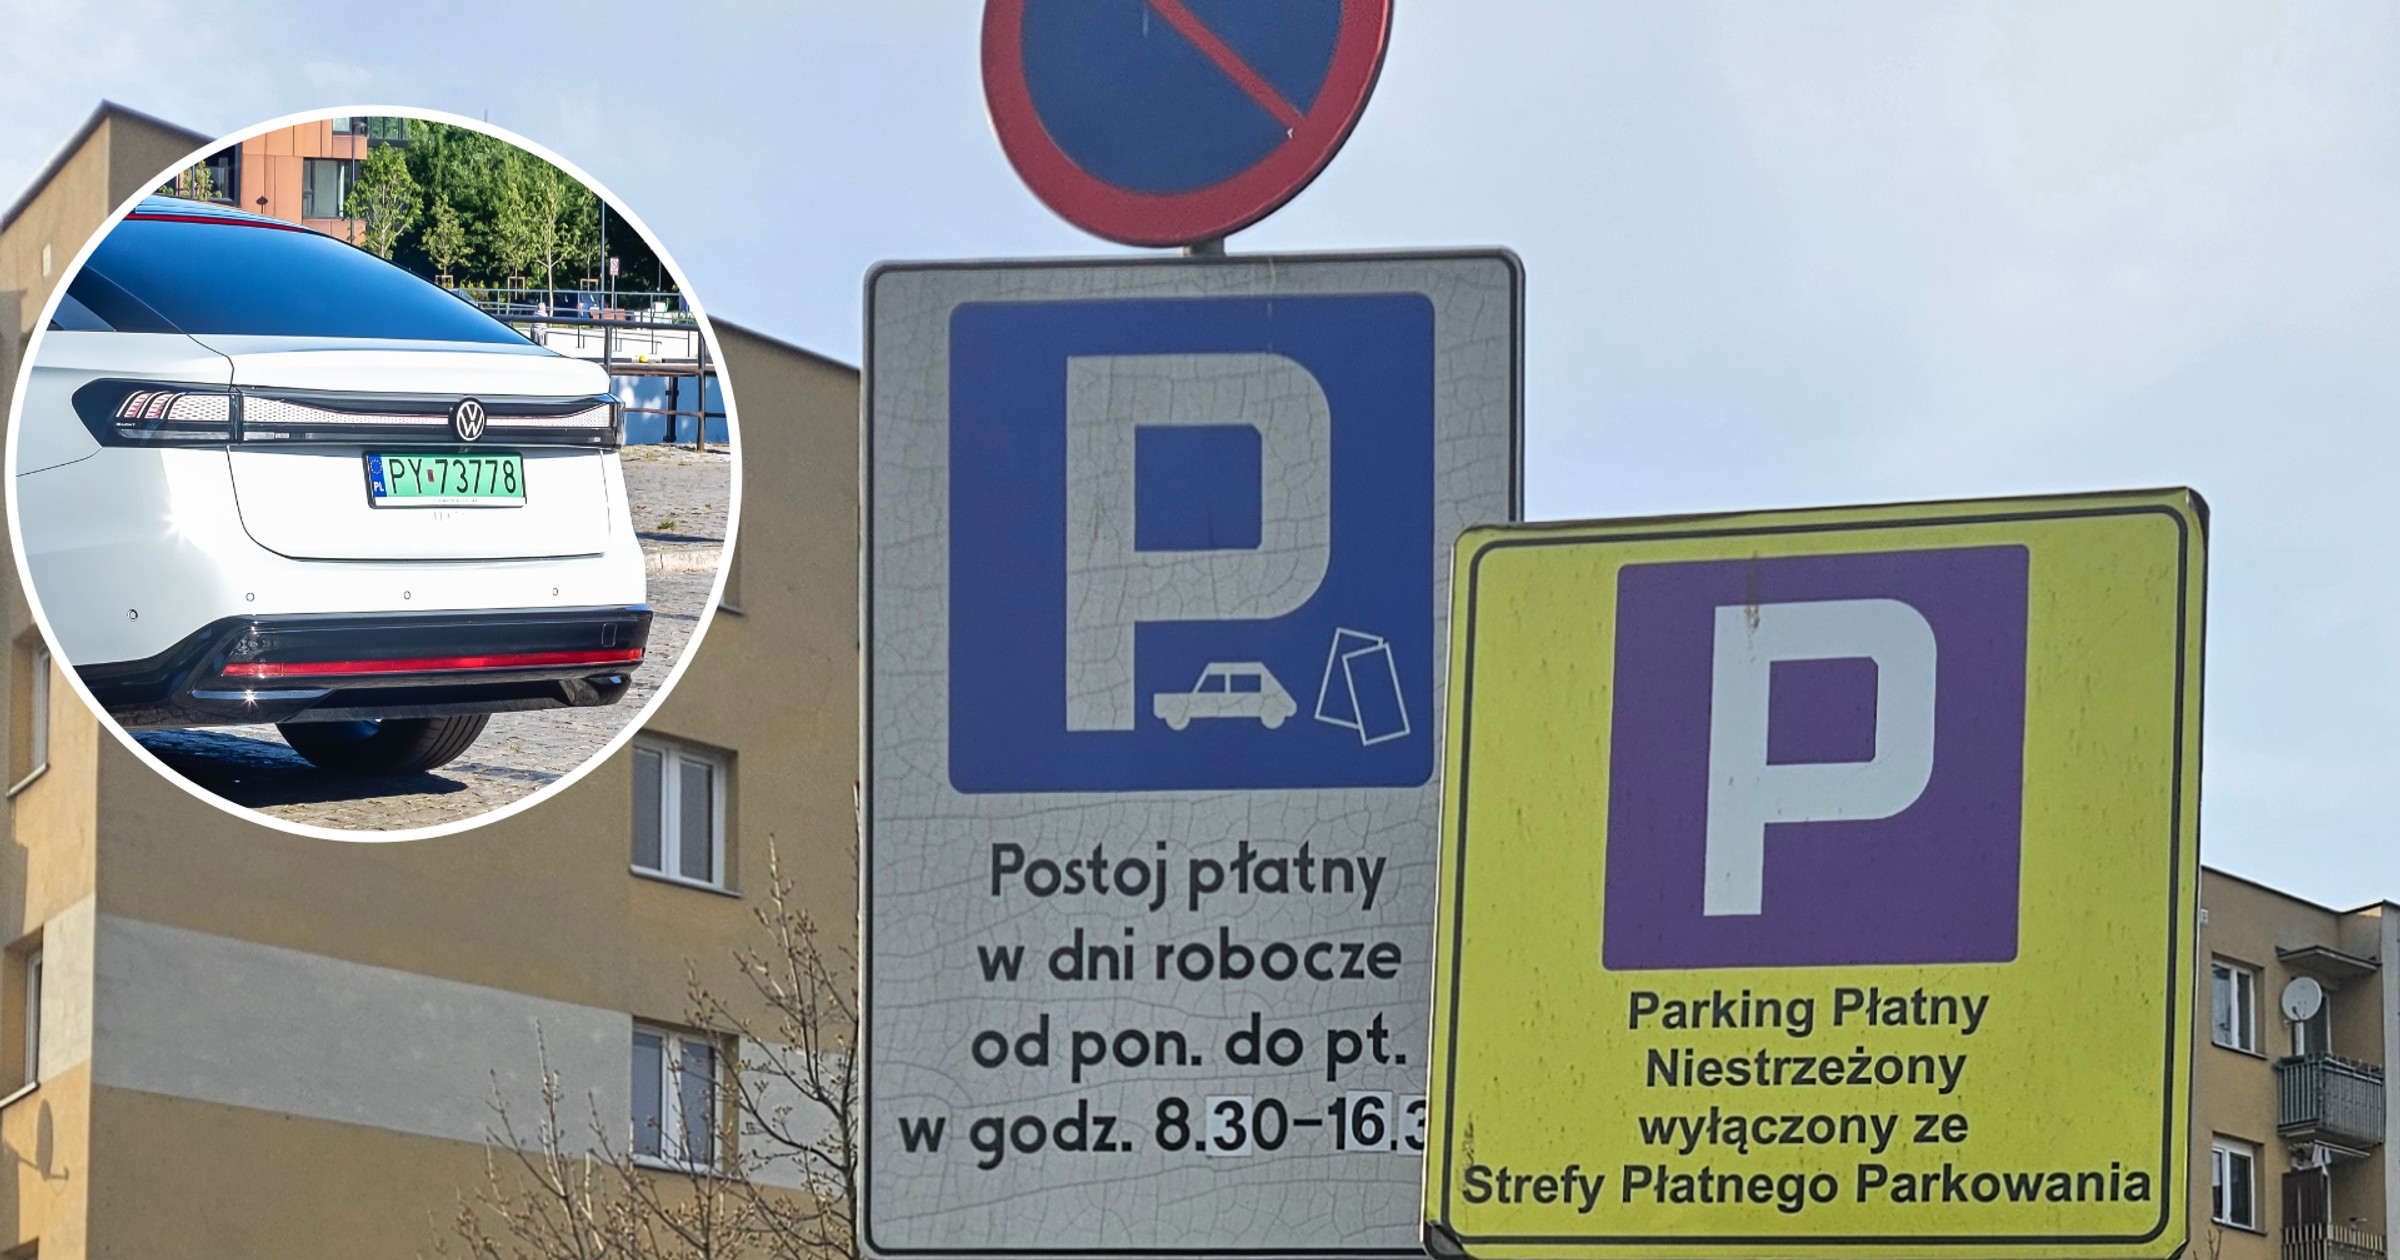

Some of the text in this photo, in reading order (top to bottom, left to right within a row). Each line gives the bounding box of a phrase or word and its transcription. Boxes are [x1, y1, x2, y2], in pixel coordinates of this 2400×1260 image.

[373, 481, 385, 493] PL
[389, 458, 516, 494] PY 73778
[1066, 352, 1331, 731] P
[1703, 598, 1937, 916] P
[991, 840, 1387, 912] Postoj płatny
[977, 925, 1402, 982] w dni robocze
[1629, 986, 1990, 1038] Parking Płatny
[971, 1011, 1407, 1084] od pon. do pt.
[1646, 1045, 1967, 1095] Niestrzeżony
[898, 1116, 947, 1153] w
[969, 1098, 1133, 1171] godz.
[1638, 1105, 1969, 1156] wyłączony ze
[1462, 1162, 2151, 1214] Strefy Płatnego Parkowania
